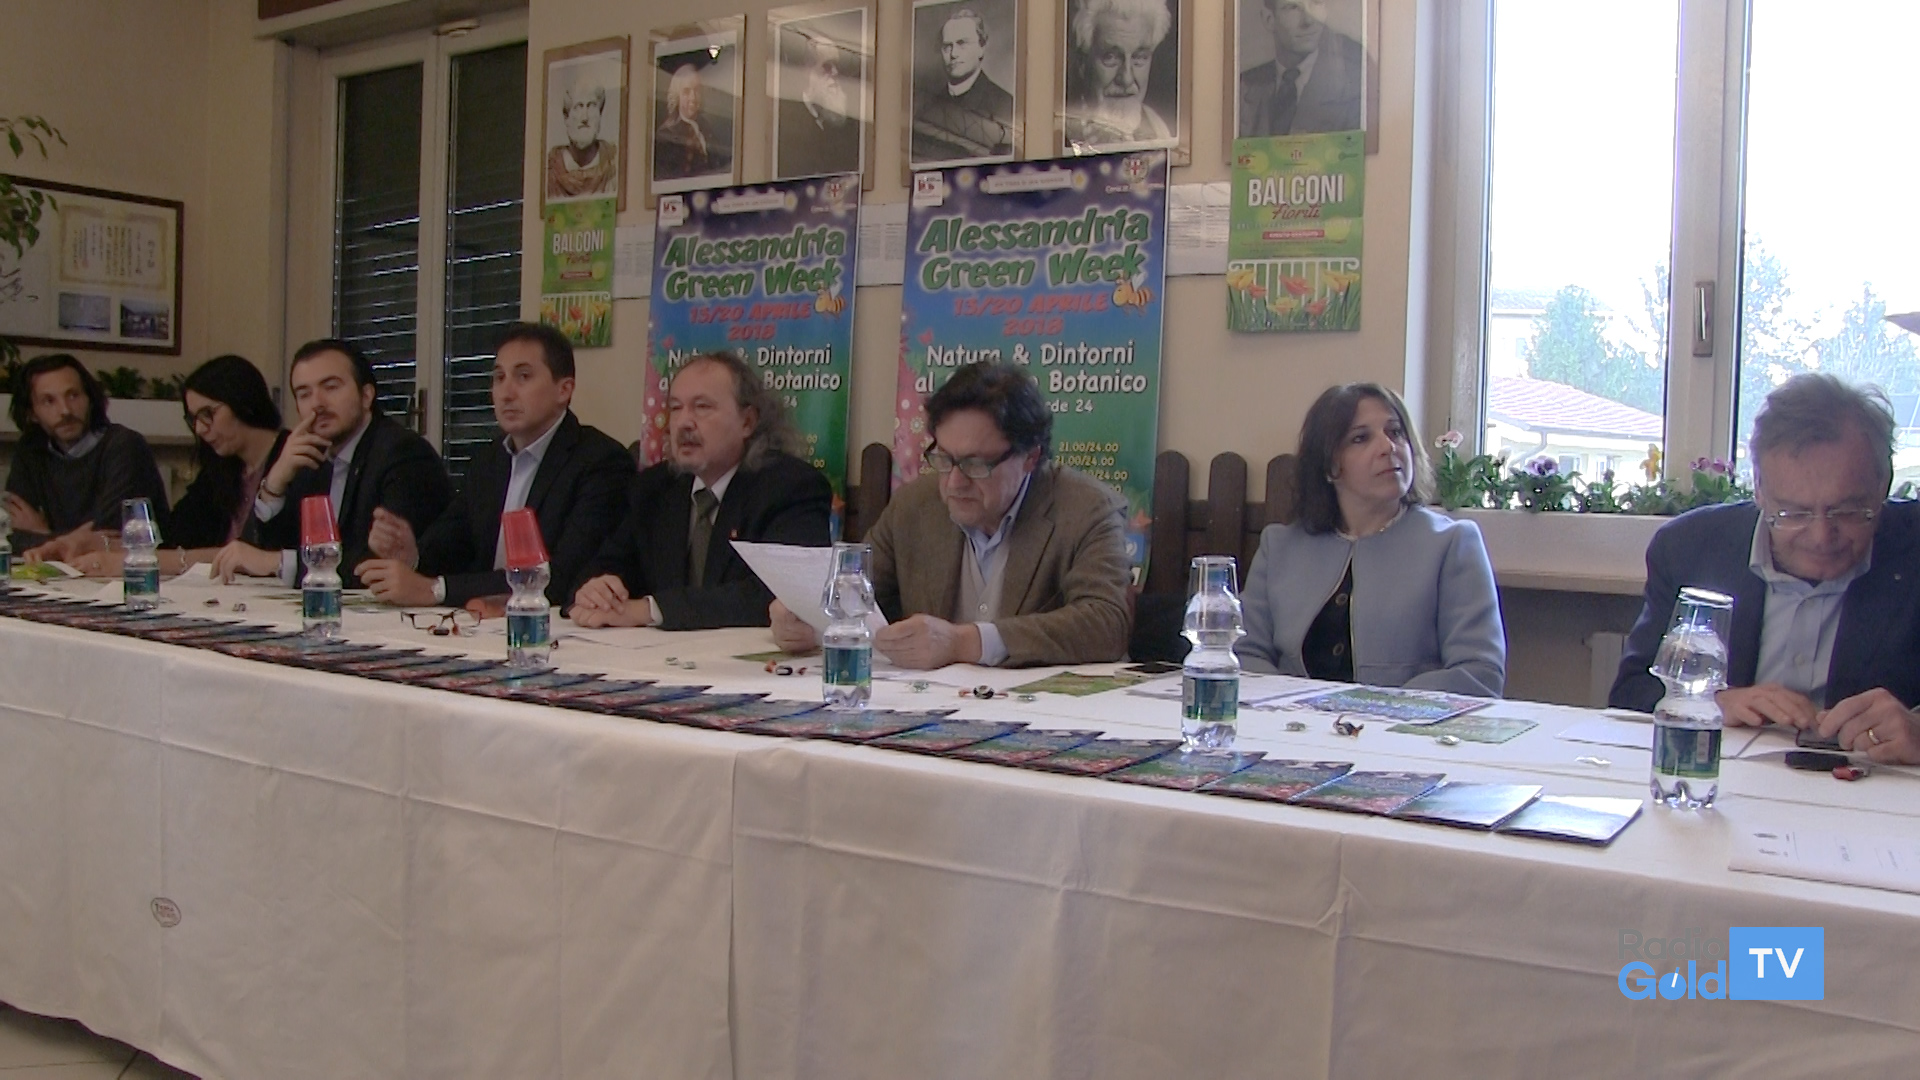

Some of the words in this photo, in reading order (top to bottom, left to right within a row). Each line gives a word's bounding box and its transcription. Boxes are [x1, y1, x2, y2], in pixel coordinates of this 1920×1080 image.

[1247, 173, 1345, 207] BALCONI
[552, 229, 605, 256] BALCONI
[917, 206, 1151, 255] Alessandria
[662, 224, 847, 268] Alessandria
[664, 270, 755, 301] Green
[763, 257, 842, 297] Week
[921, 256, 1036, 291] Green
[1048, 243, 1146, 288] Week
[747, 302, 813, 323] APRILE
[1027, 291, 1111, 315] APRILE
[726, 323, 777, 342] 2018
[1001, 314, 1065, 337] 2018
[756, 342, 833, 368] Dintorni
[926, 343, 1002, 366] Natura
[1012, 342, 1031, 365] &
[1040, 339, 1136, 366] Dintorni
[763, 368, 842, 391] Botanico
[914, 371, 935, 393] al
[1048, 368, 1149, 393] Botanico
[1075, 399, 1095, 413] 24
